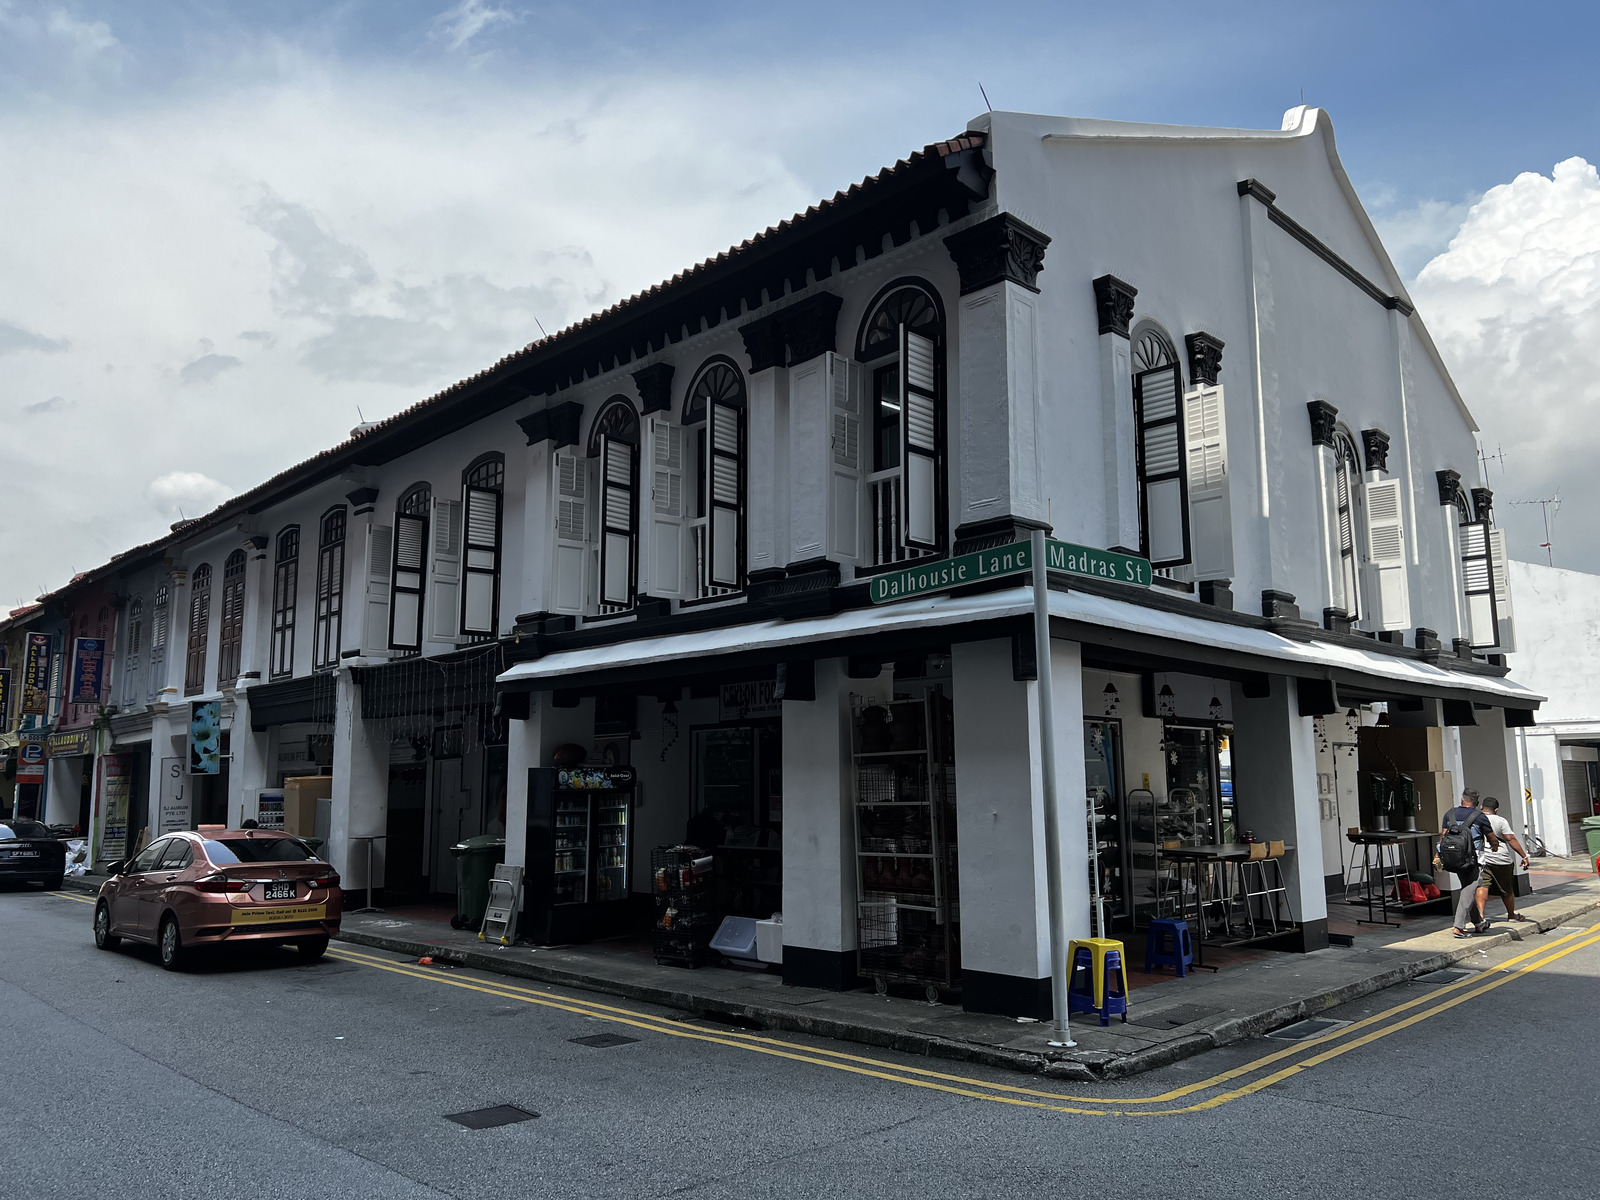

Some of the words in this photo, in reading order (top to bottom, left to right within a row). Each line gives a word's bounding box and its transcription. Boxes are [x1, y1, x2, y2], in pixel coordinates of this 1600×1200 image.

[879, 562, 967, 598] Dalhousie
[979, 550, 1026, 575] Lane
[1051, 545, 1116, 578] Madras
[1126, 560, 1143, 583] St
[26, 645, 38, 707] ALLAUDDIN'S
[759, 680, 781, 704] FOO
[265, 890, 296, 899] 2466K
[272, 882, 290, 891] SHD
